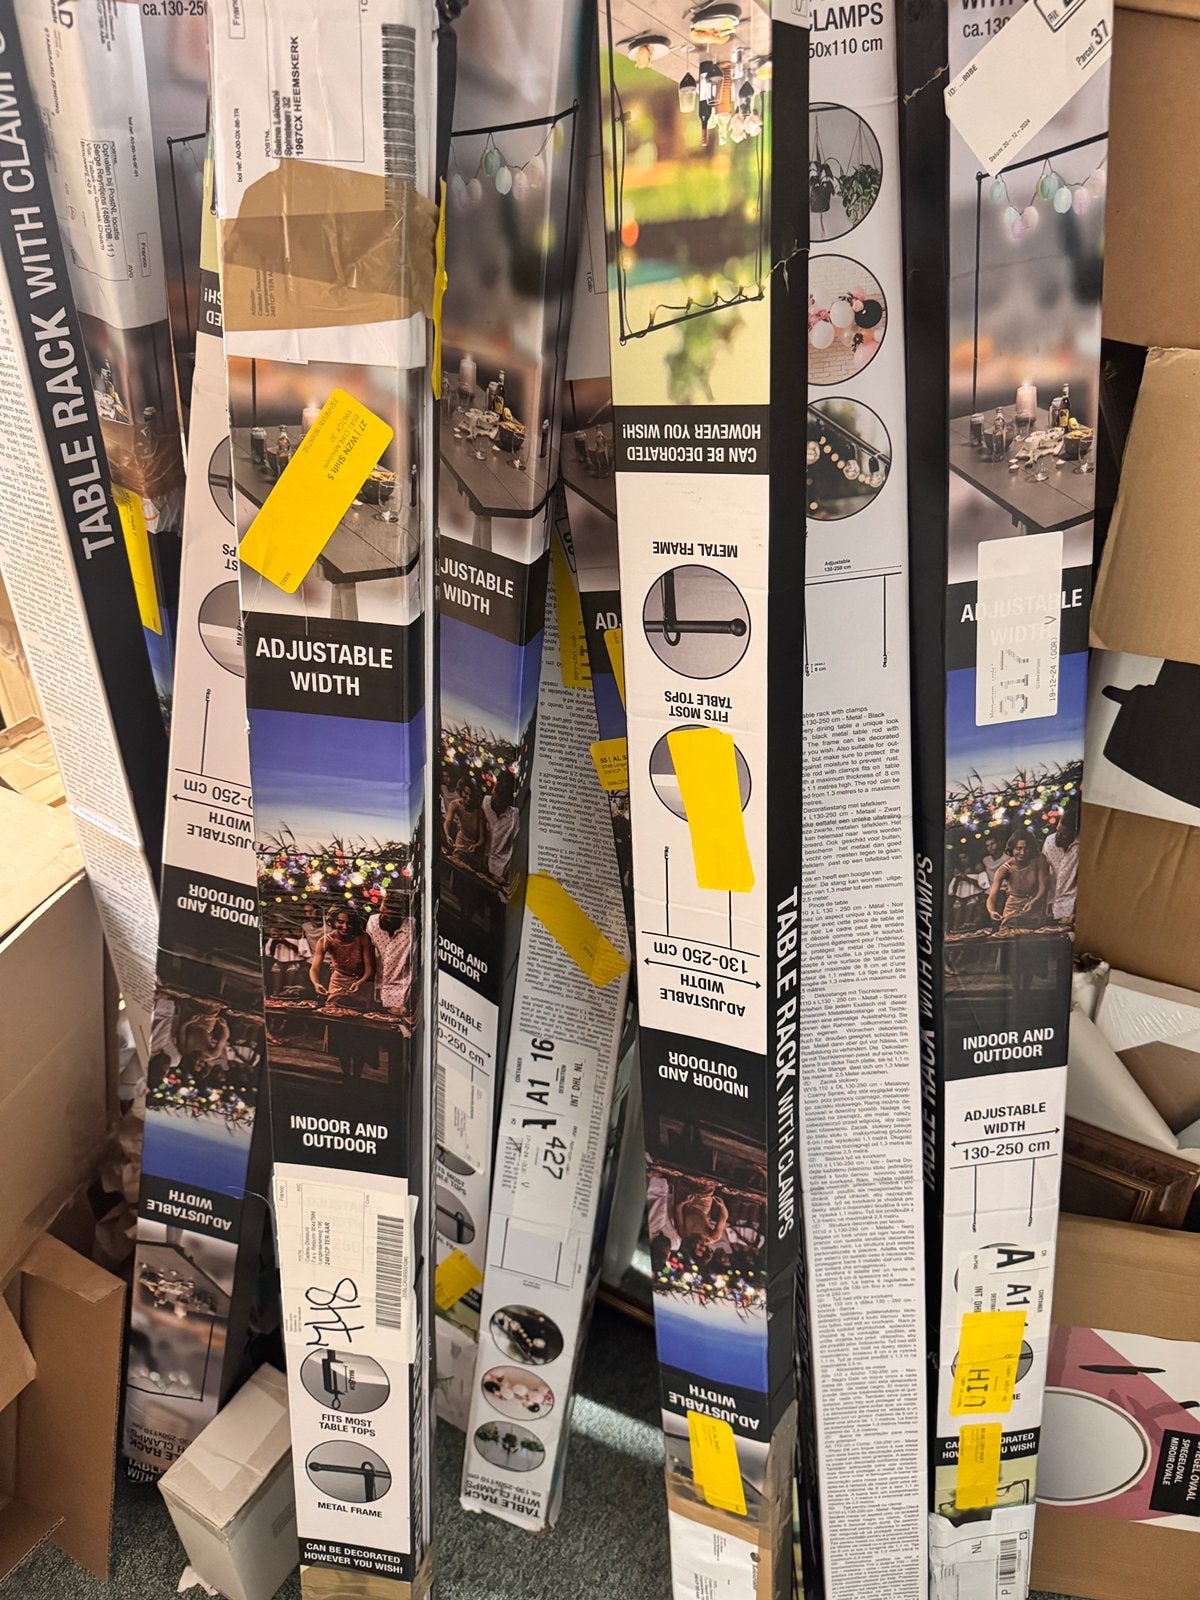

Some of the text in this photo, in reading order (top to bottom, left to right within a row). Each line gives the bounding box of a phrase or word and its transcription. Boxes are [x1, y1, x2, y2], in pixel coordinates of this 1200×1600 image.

[862, 37, 883, 53] cm
[1090, 18, 1110, 46] 37
[290, 36, 304, 156] 1967CX HEEMSKERK
[0, 30, 36, 193] CLAM
[101, 143, 113, 178] Ophalen
[10, 205, 57, 300] WITH
[30, 306, 88, 429] RACK
[622, 424, 761, 440] HOWEVER YOU WISH!
[626, 446, 757, 463] CAN BE DECORATED
[61, 435, 116, 561] TABLE
[652, 540, 739, 558] METAL FRAME
[440, 556, 515, 600] JUSTABLE
[443, 583, 491, 616] WIDTH
[595, 612, 622, 630] AD
[255, 637, 394, 669] ADJUSTABLE
[289, 671, 361, 697] WIDTH
[664, 690, 732, 709] TABLE TOPS
[668, 705, 729, 723] FITS MOST
[184, 778, 207, 795] cm
[208, 811, 251, 833] WIDTH
[187, 823, 256, 852] JUSTABLE
[188, 883, 255, 912] OUTDOOR
[916, 853, 933, 956] CLAMPS
[177, 896, 260, 928] NDOOR AND
[439, 948, 481, 983] UTDOOR
[466, 953, 488, 975] AND
[653, 940, 749, 975] 130-250 cm
[680, 973, 725, 995] WIDTH
[439, 998, 483, 1033] JUSTABLE
[659, 987, 746, 1018] ADJUSTABLE
[440, 1010, 469, 1036] WIDTH
[530, 1037, 556, 1063] 16
[962, 1027, 1055, 1050] INDOOR AND
[468, 1049, 485, 1067] cm
[668, 1050, 738, 1079] OUTDOOR
[776, 885, 798, 1240] TABLE RACK WITH CLAMPS
[973, 1044, 1043, 1064] OUTDOOR
[526, 1078, 551, 1106] A1
[658, 1065, 749, 1099] INDOOR AND
[964, 1101, 1047, 1123] ADJUSTABLE
[290, 1114, 389, 1141] INDOOR AND
[983, 1120, 1026, 1135] WIDTH
[302, 1132, 378, 1155] OUTDOOR
[962, 1138, 1051, 1161] 130-250 cm
[543, 1136, 568, 1181] 427
[168, 1188, 213, 1212] WIDTH
[146, 1199, 232, 1232] ADJUSTABLE
[996, 1248, 1036, 1269] A
[1006, 1283, 1032, 1306] A1
[688, 1383, 736, 1409] WIDTH
[321, 1412, 373, 1428] FITS MOST
[669, 1391, 760, 1431] ADJUSTABLE
[318, 1420, 376, 1438] TABLE TOPS
[1008, 1441, 1036, 1453] WISH!
[1162, 1436, 1180, 1486] MIROIR OVALE
[513, 1493, 541, 1508] WITH
[1186, 1474, 1200, 1501] OVAAL
[317, 1500, 383, 1519] METAL FRAME
[465, 1487, 541, 1518] TABLE RACK
[304, 1550, 404, 1575] HOWEVER YOU WISH!
[305, 1541, 401, 1565] CAN BE DECORATED
